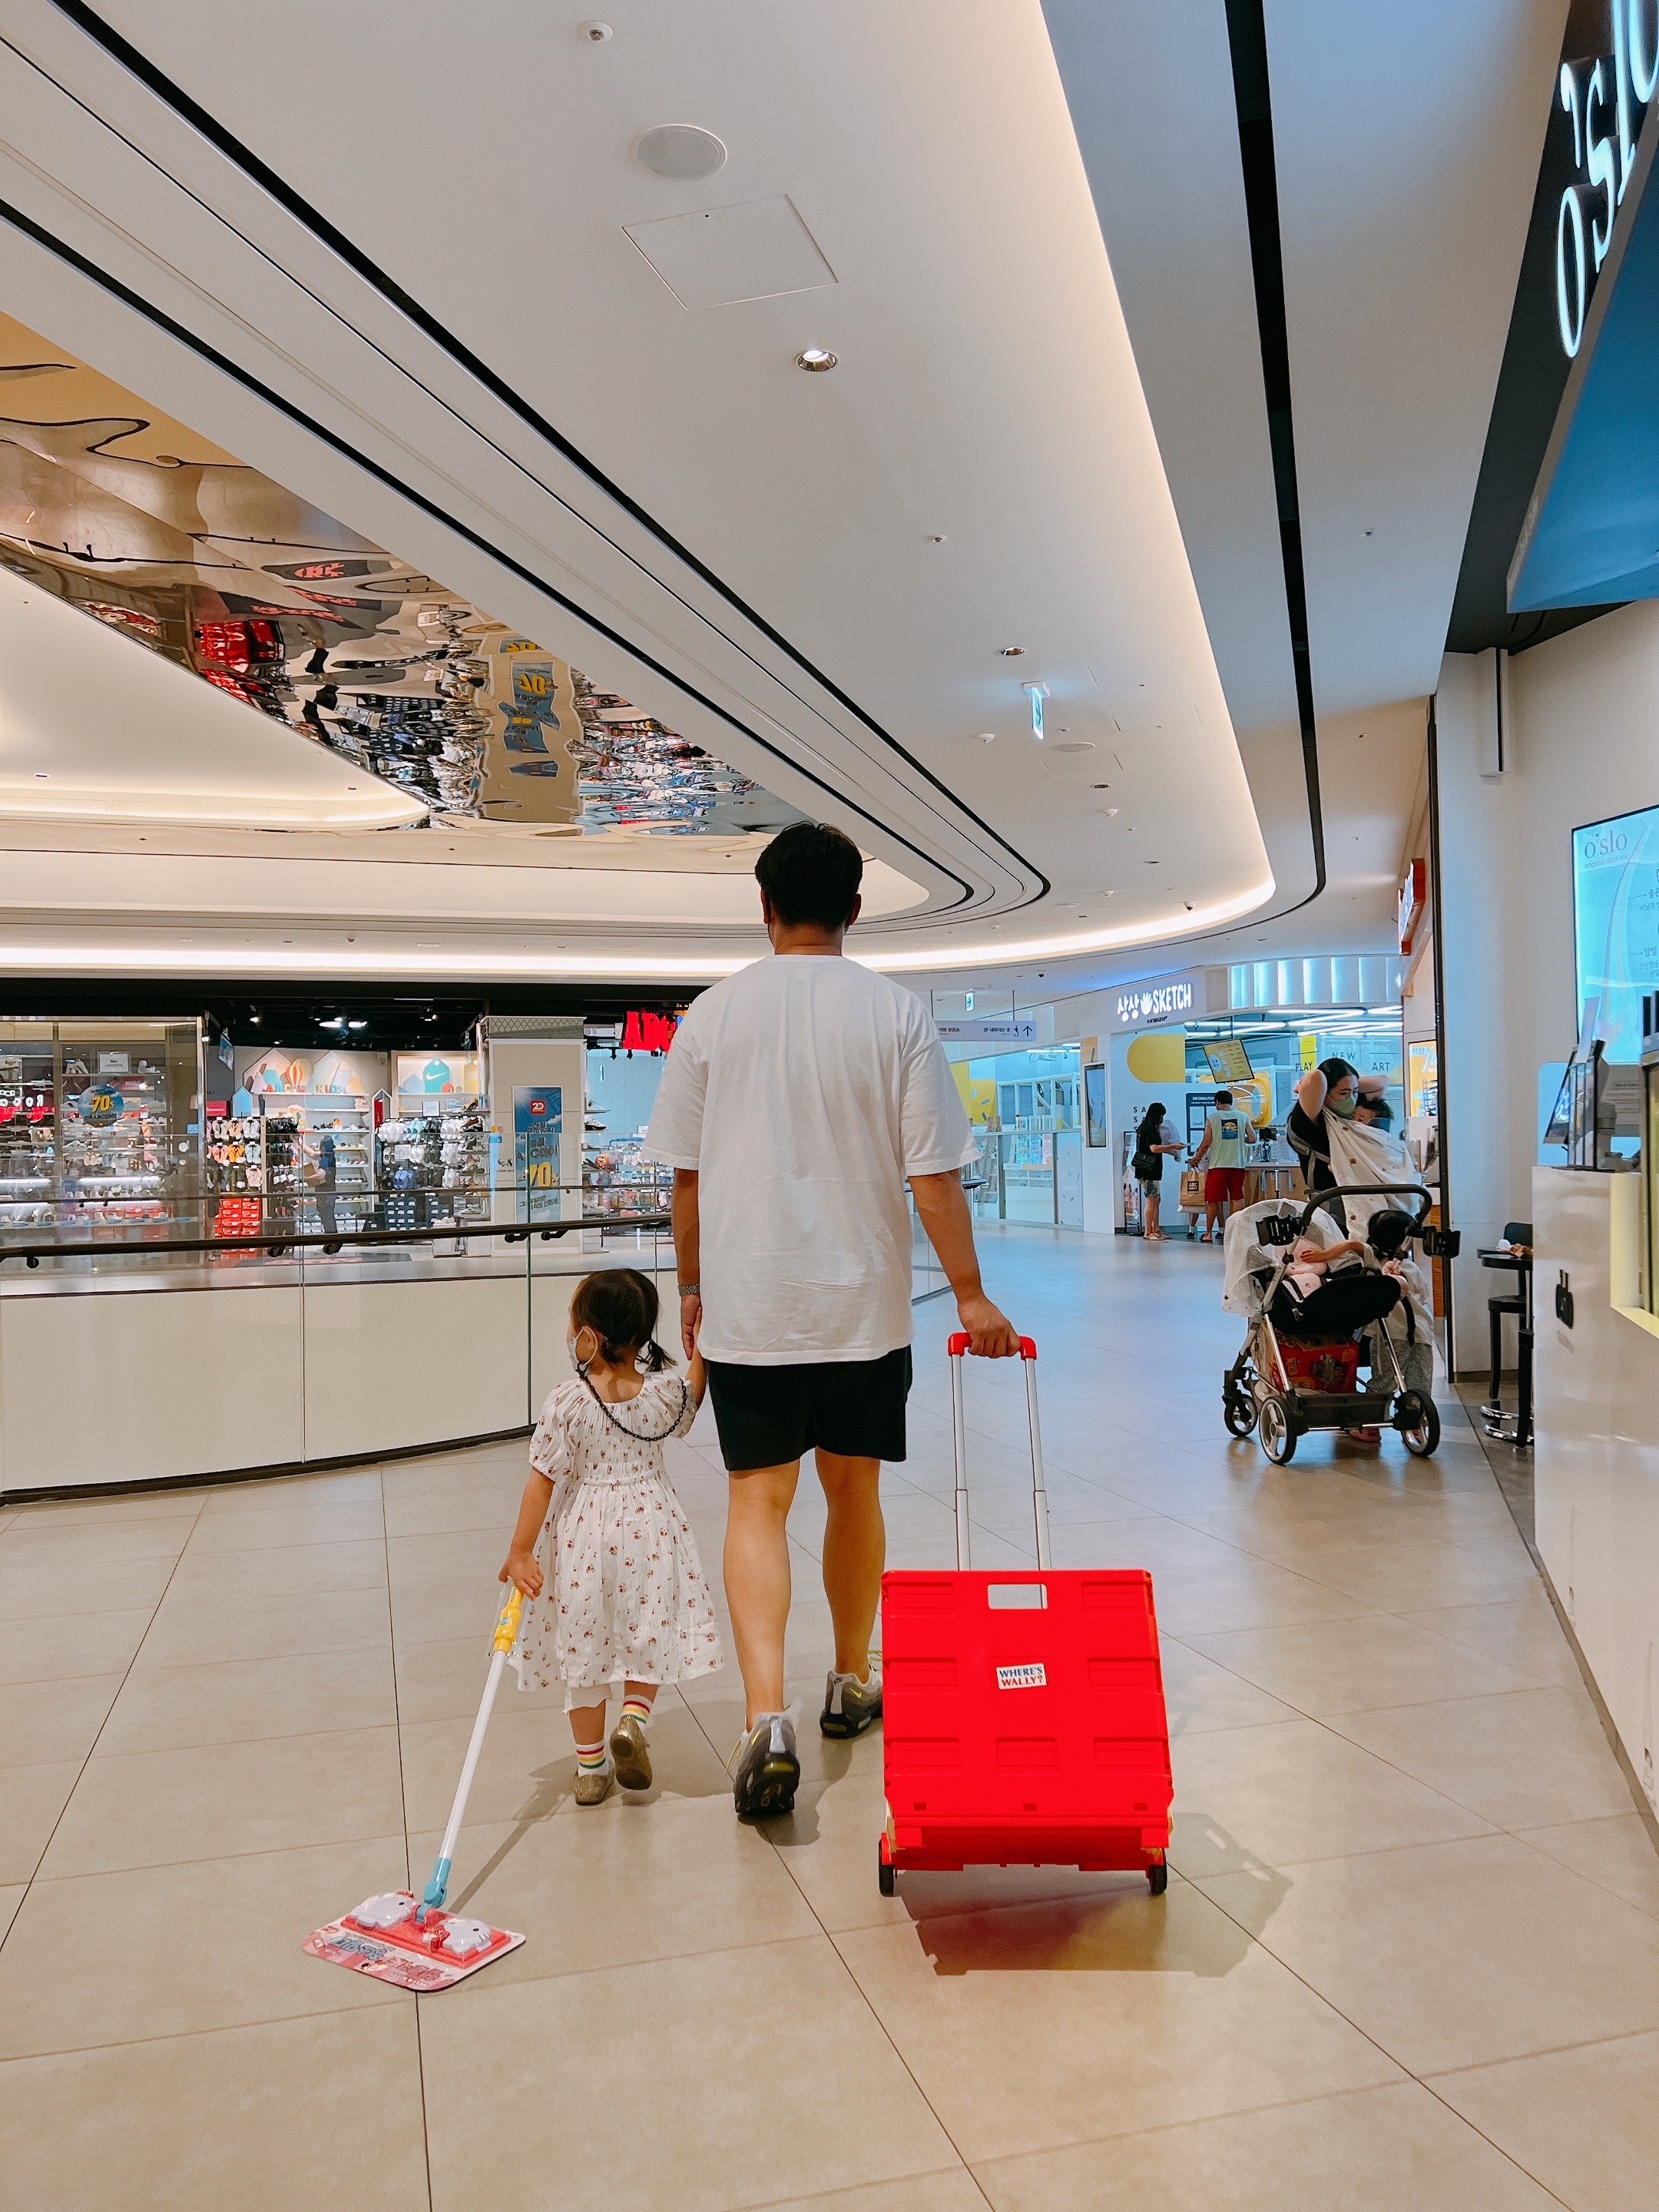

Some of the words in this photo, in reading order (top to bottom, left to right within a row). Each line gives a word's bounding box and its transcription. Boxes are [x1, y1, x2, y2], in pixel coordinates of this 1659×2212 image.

[1584, 830, 1628, 859] o'slo
[1152, 982, 1192, 1015] SKETCH
[1295, 1061, 1313, 1072] PLAY
[1372, 1062, 1390, 1071] ART
[999, 1667, 1042, 1677] WHERE'S
[1002, 1675, 1043, 1687] WALLY?
